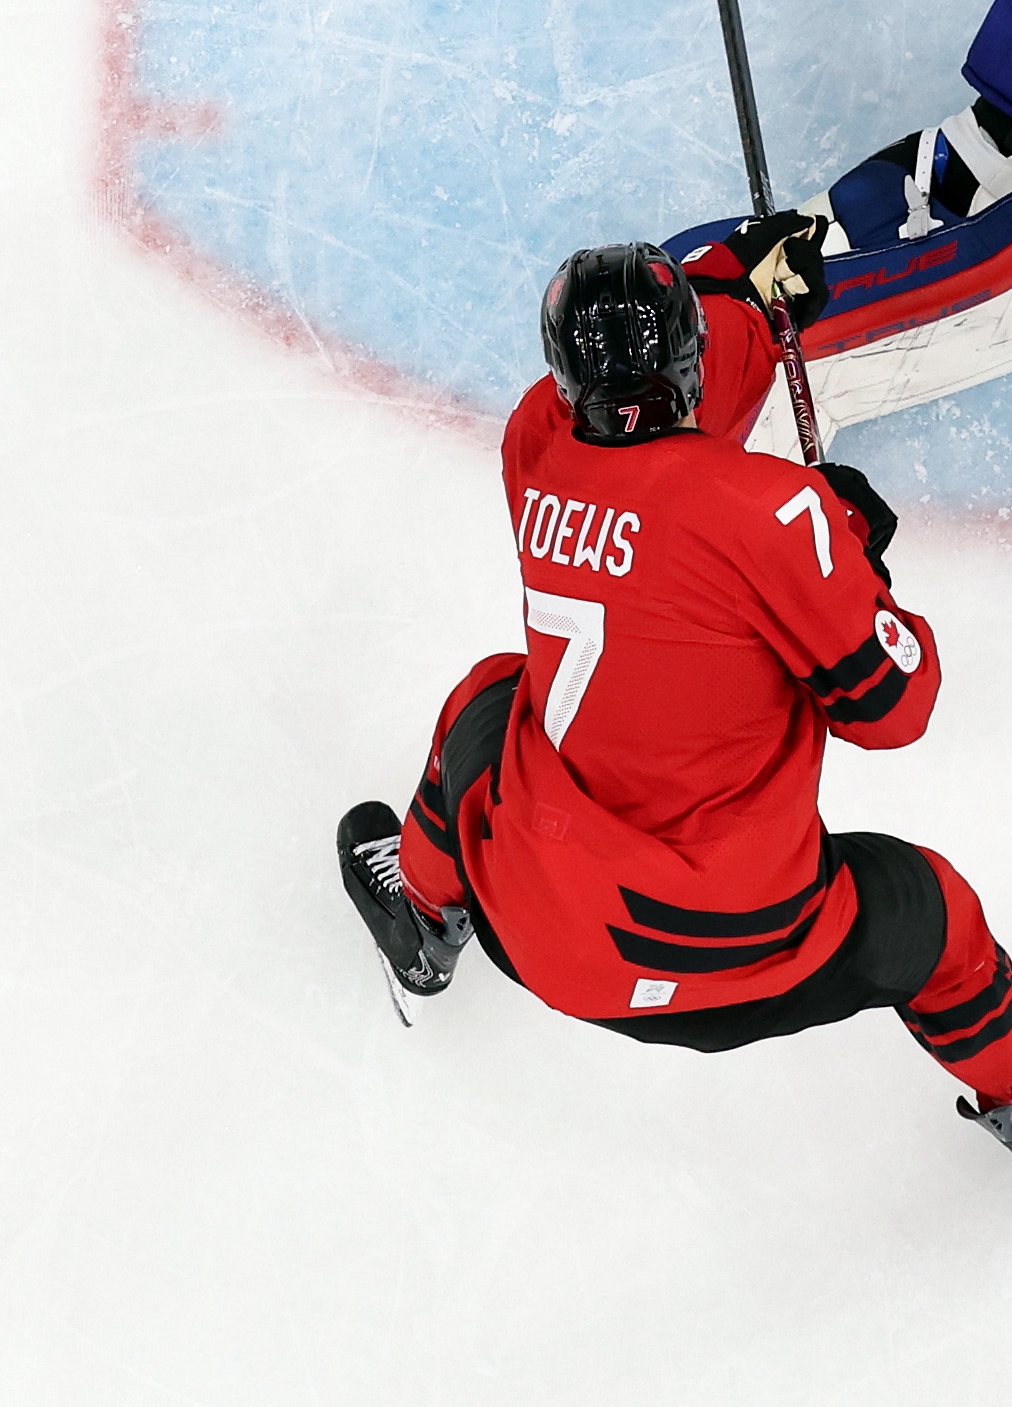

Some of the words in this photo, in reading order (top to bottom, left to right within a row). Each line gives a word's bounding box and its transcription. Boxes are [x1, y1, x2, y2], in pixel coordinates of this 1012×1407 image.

[827, 240, 959, 300] RUE
[618, 405, 640, 433] 7
[518, 487, 641, 578] TOEWS
[774, 485, 834, 579] 7
[525, 585, 606, 753] 7
